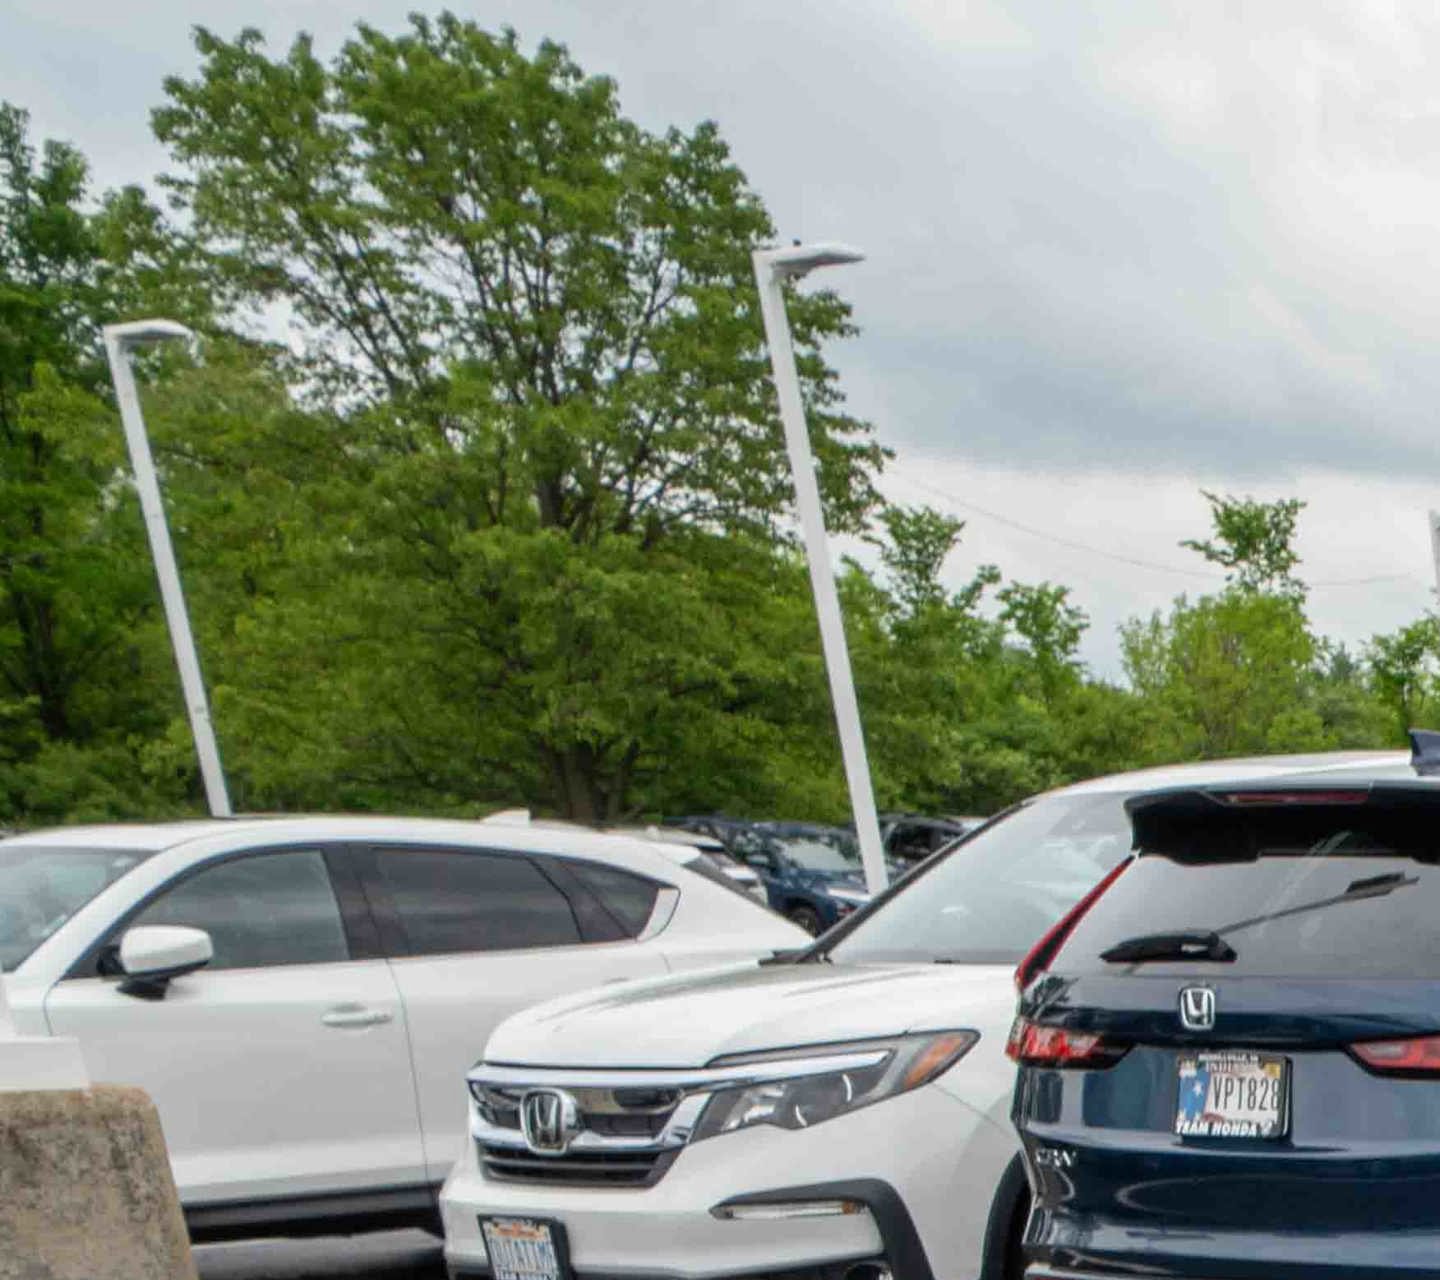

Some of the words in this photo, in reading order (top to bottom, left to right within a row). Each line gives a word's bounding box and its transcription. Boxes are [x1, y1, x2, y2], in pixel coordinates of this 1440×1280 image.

[1213, 1077, 1281, 1111] VPT828
[1176, 1120, 1209, 1135] TEAM
[1211, 1120, 1258, 1137] HONDA
